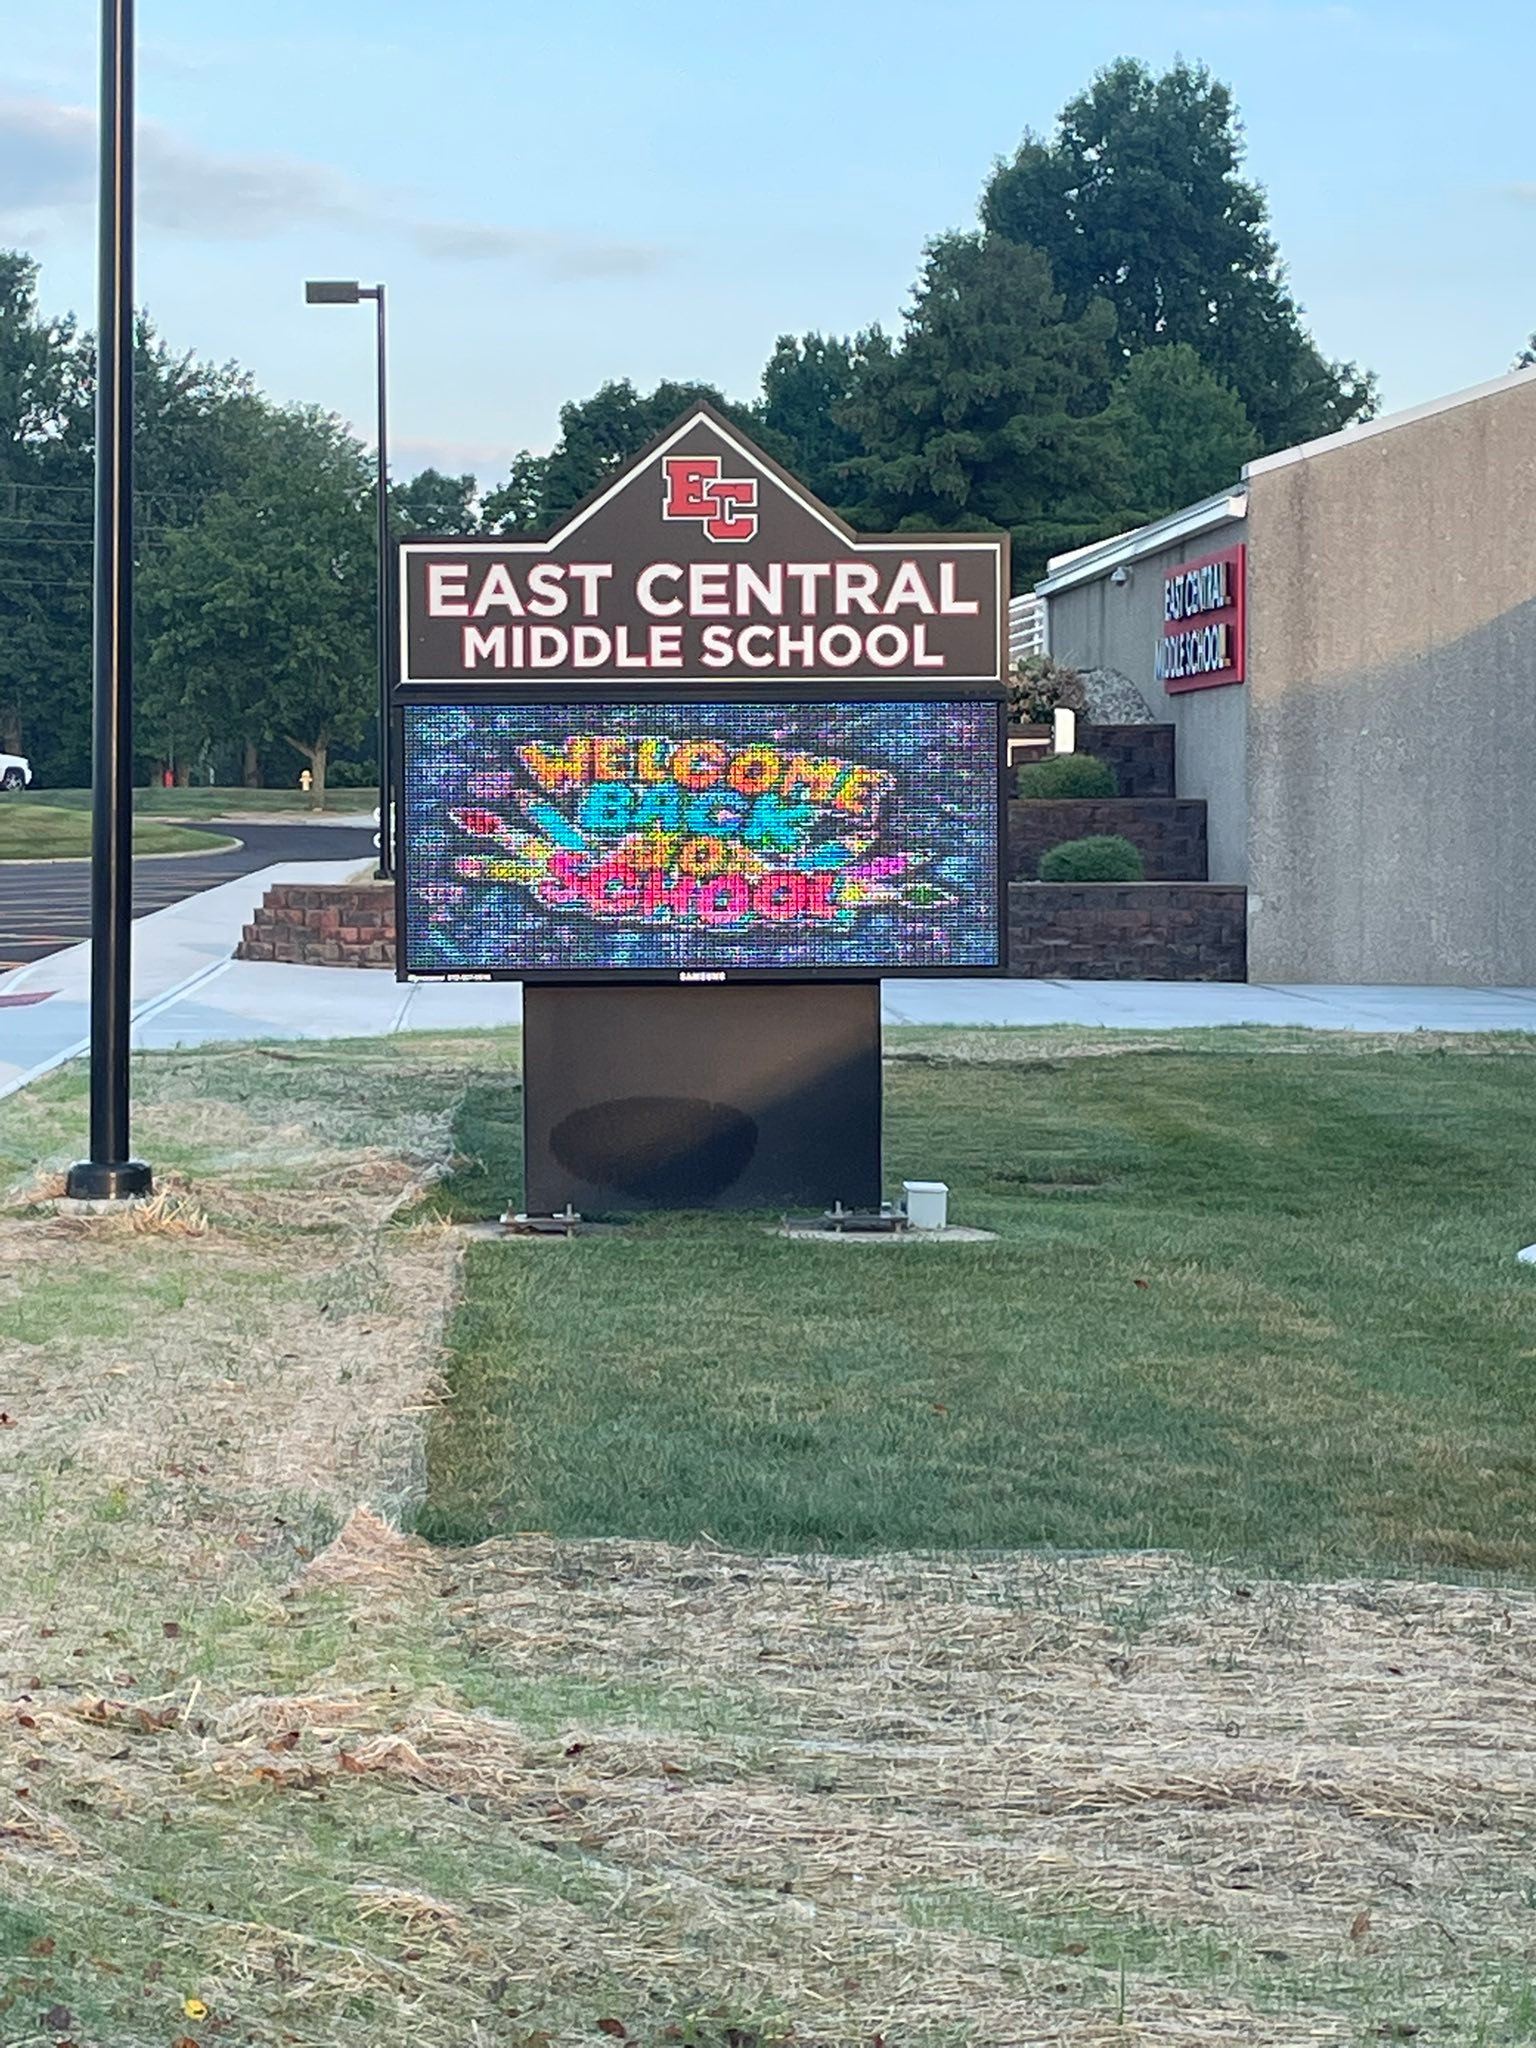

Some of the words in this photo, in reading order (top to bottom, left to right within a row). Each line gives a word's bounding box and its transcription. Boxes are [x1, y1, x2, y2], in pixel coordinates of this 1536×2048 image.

[426, 561, 614, 618] EAST
[635, 560, 979, 617] CENTRAL
[1164, 575, 1184, 621] EAST
[461, 624, 684, 669] MIDDLE
[700, 623, 945, 669] SCHOOL
[516, 736, 886, 812] WELCOME
[579, 781, 816, 850] BACK
[540, 851, 840, 925] SCHOOL
[679, 971, 727, 982] SAMSUNG
